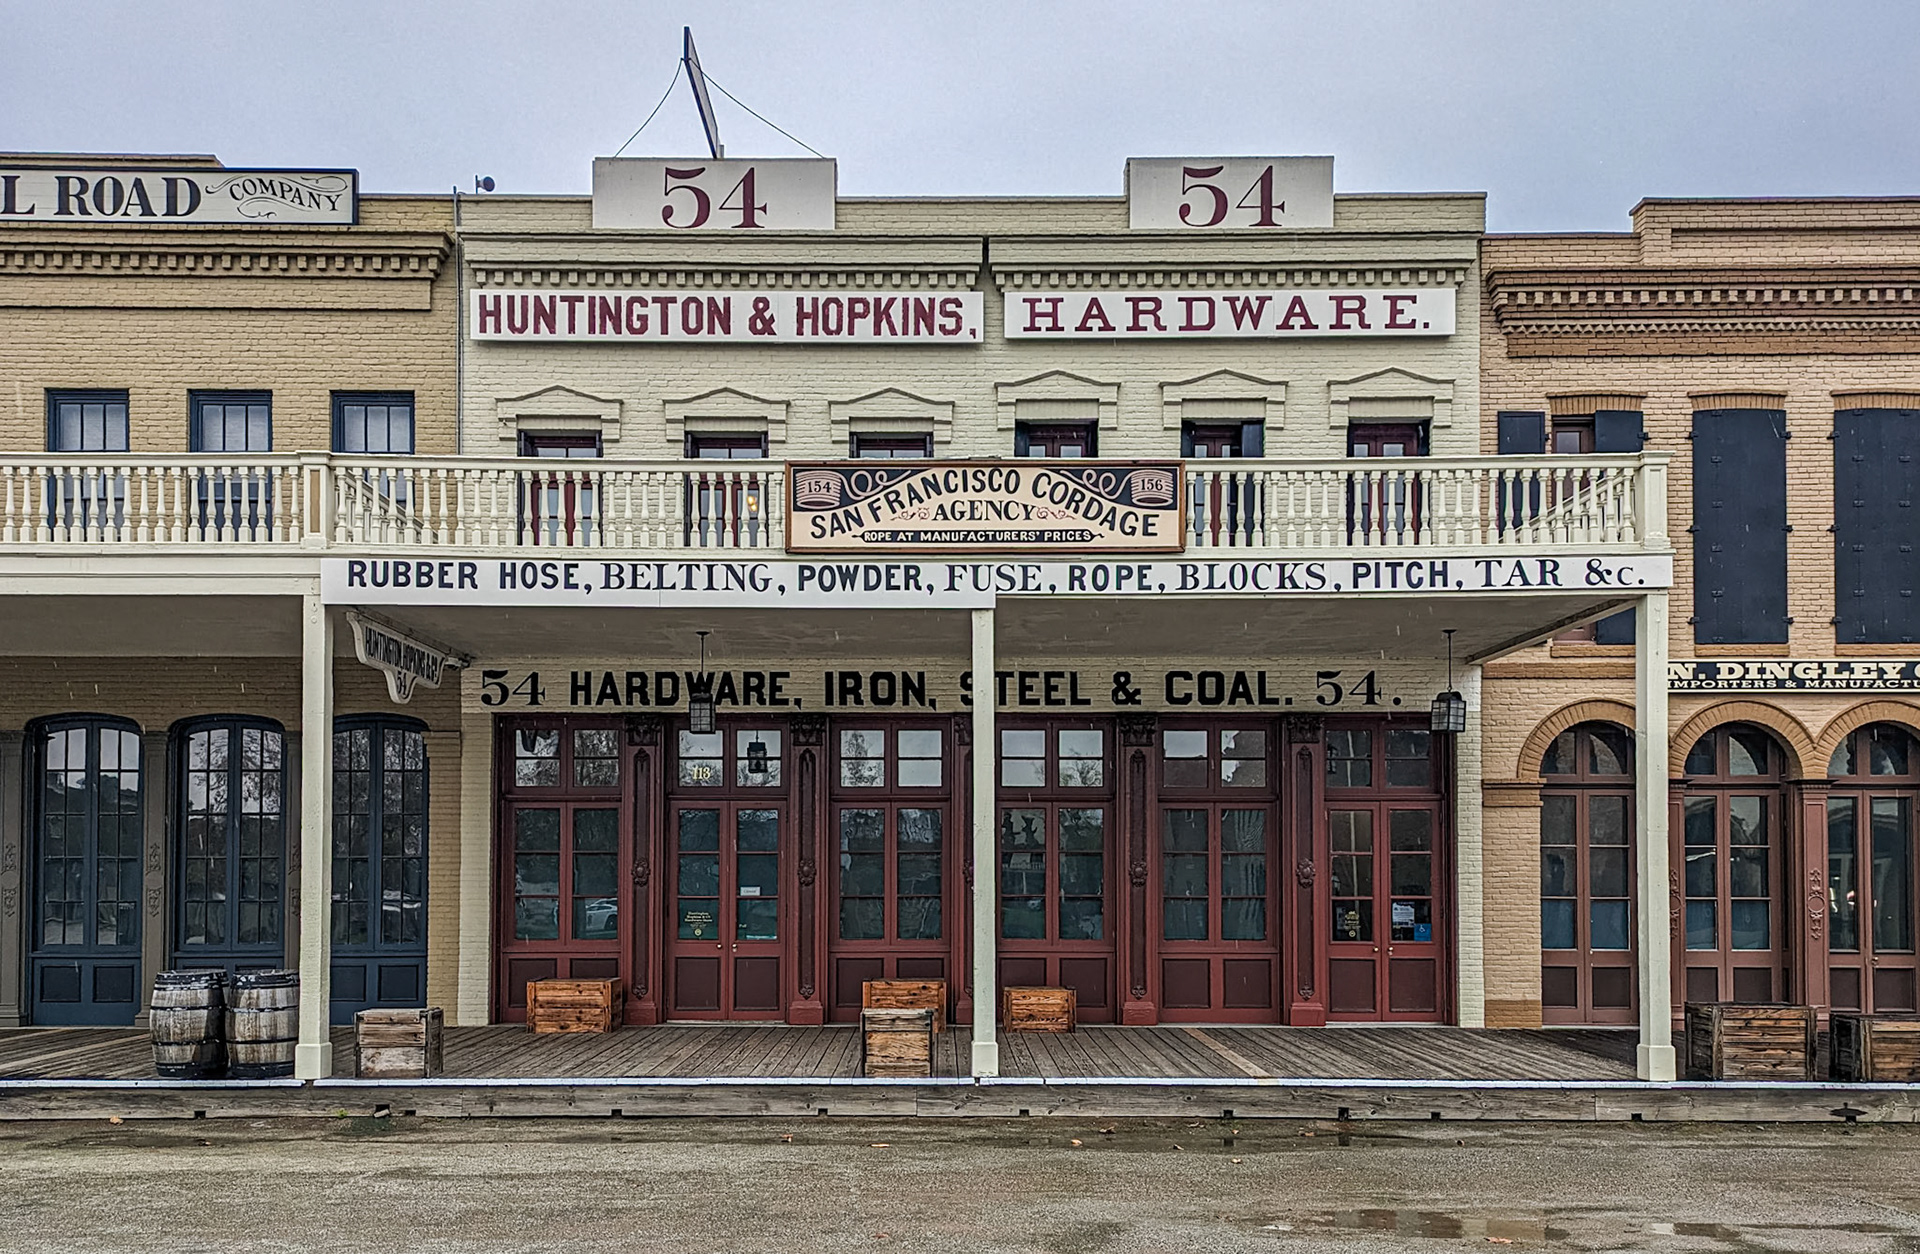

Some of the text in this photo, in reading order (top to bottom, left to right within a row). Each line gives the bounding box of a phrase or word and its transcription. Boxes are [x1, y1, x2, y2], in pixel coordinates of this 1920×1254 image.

[53, 175, 202, 218] ROAD
[229, 177, 343, 213] COMPANY
[661, 167, 768, 229] 54
[1178, 165, 1286, 227] 54
[477, 294, 977, 340] HUNTINGTON & HOPKINS,
[1022, 294, 1431, 332] HARDWARE.
[806, 480, 831, 494] 154
[810, 468, 1160, 539] SAN FRANCISCO CORDAGE
[1140, 478, 1164, 492] 156
[931, 499, 1036, 522] AGENCY
[864, 529, 1092, 543] ROPE AT MANUFACTURERS' PRICES
[348, 560, 478, 590] RUBBER
[499, 562, 592, 595] HOSE,
[600, 563, 787, 596] BELTING,
[798, 564, 935, 596] POWDER,
[943, 564, 1058, 595] FUSE,
[1068, 564, 1167, 594] ROPE,
[1176, 562, 1342, 592] BLOCKS,
[1352, 560, 1463, 591] PITCH,
[1475, 558, 1563, 588] TAR
[480, 670, 545, 706] 54
[570, 671, 801, 709] HARDWARE,
[825, 671, 936, 710] IRON,
[1111, 671, 1141, 705] &
[1165, 671, 1293, 706] COAL.
[1668, 680, 1777, 689] IMPORTERS
[1785, 680, 1797, 688] &
[1716, 662, 1906, 680] DINGLEY
